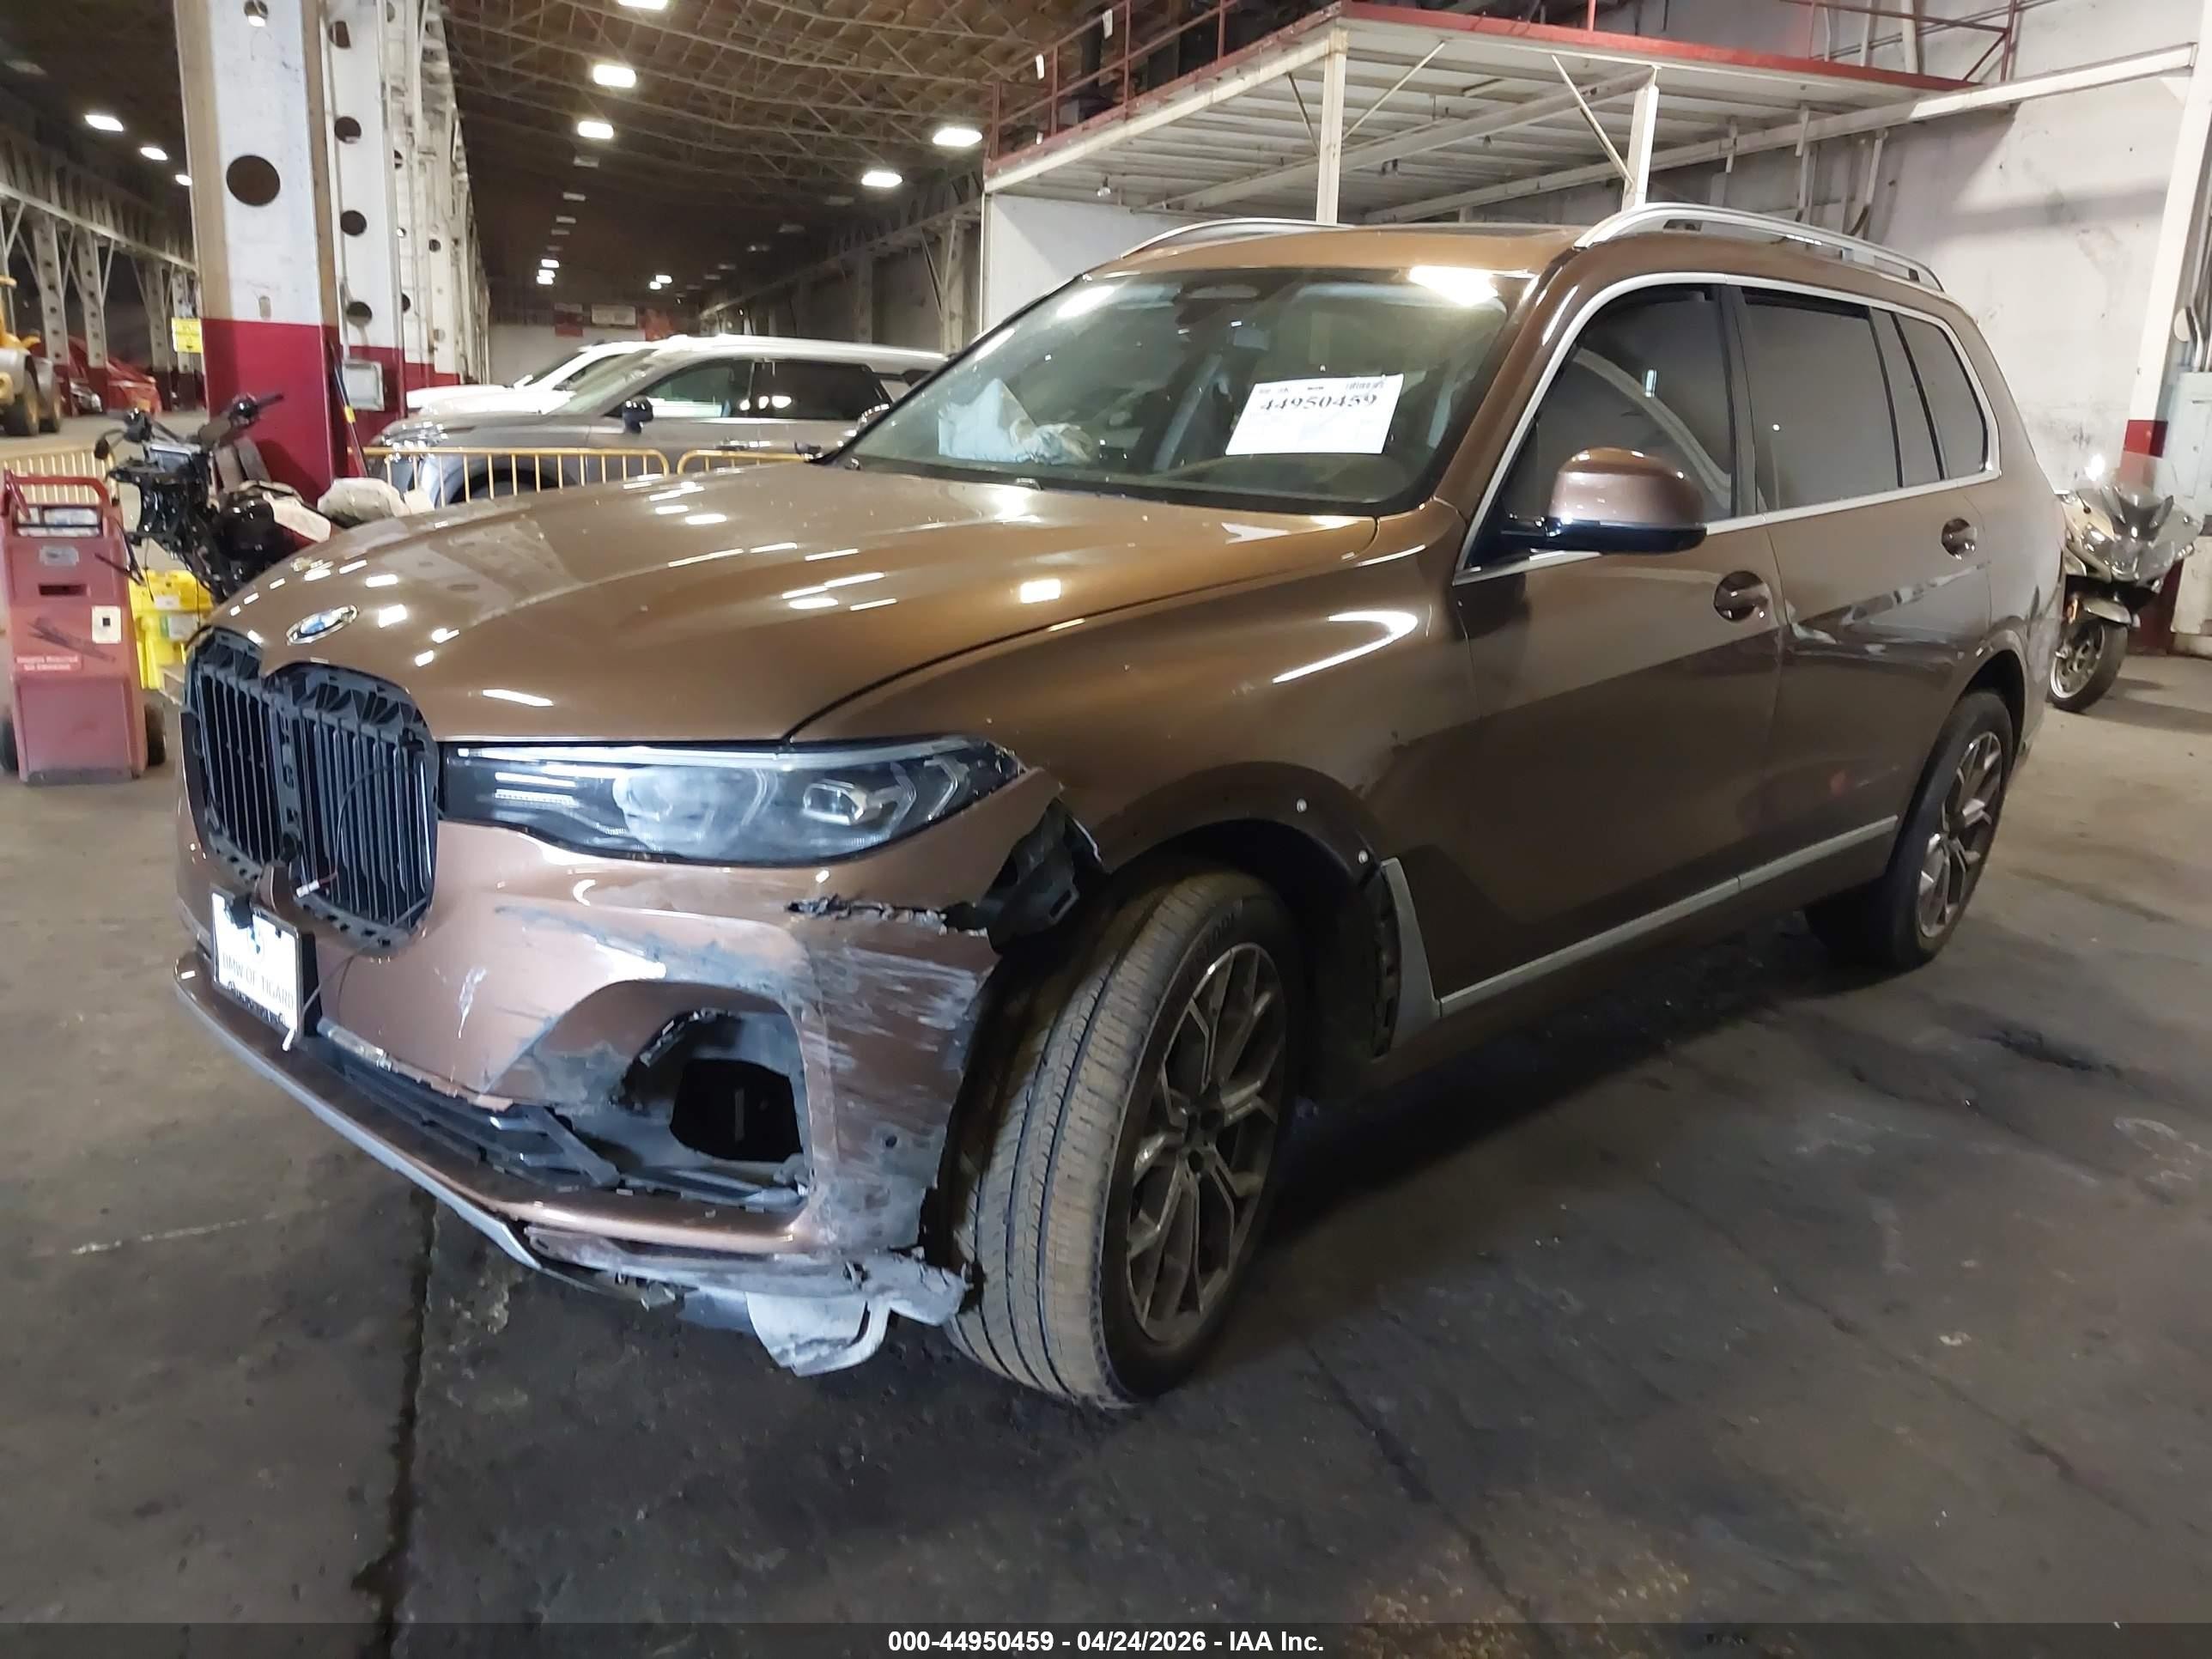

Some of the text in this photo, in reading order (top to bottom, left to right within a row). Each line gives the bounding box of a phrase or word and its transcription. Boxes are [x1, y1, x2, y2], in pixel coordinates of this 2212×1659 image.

[1260, 394, 1377, 410] 44950459
[222, 951, 244, 979] BMW
[246, 967, 257, 988] OF
